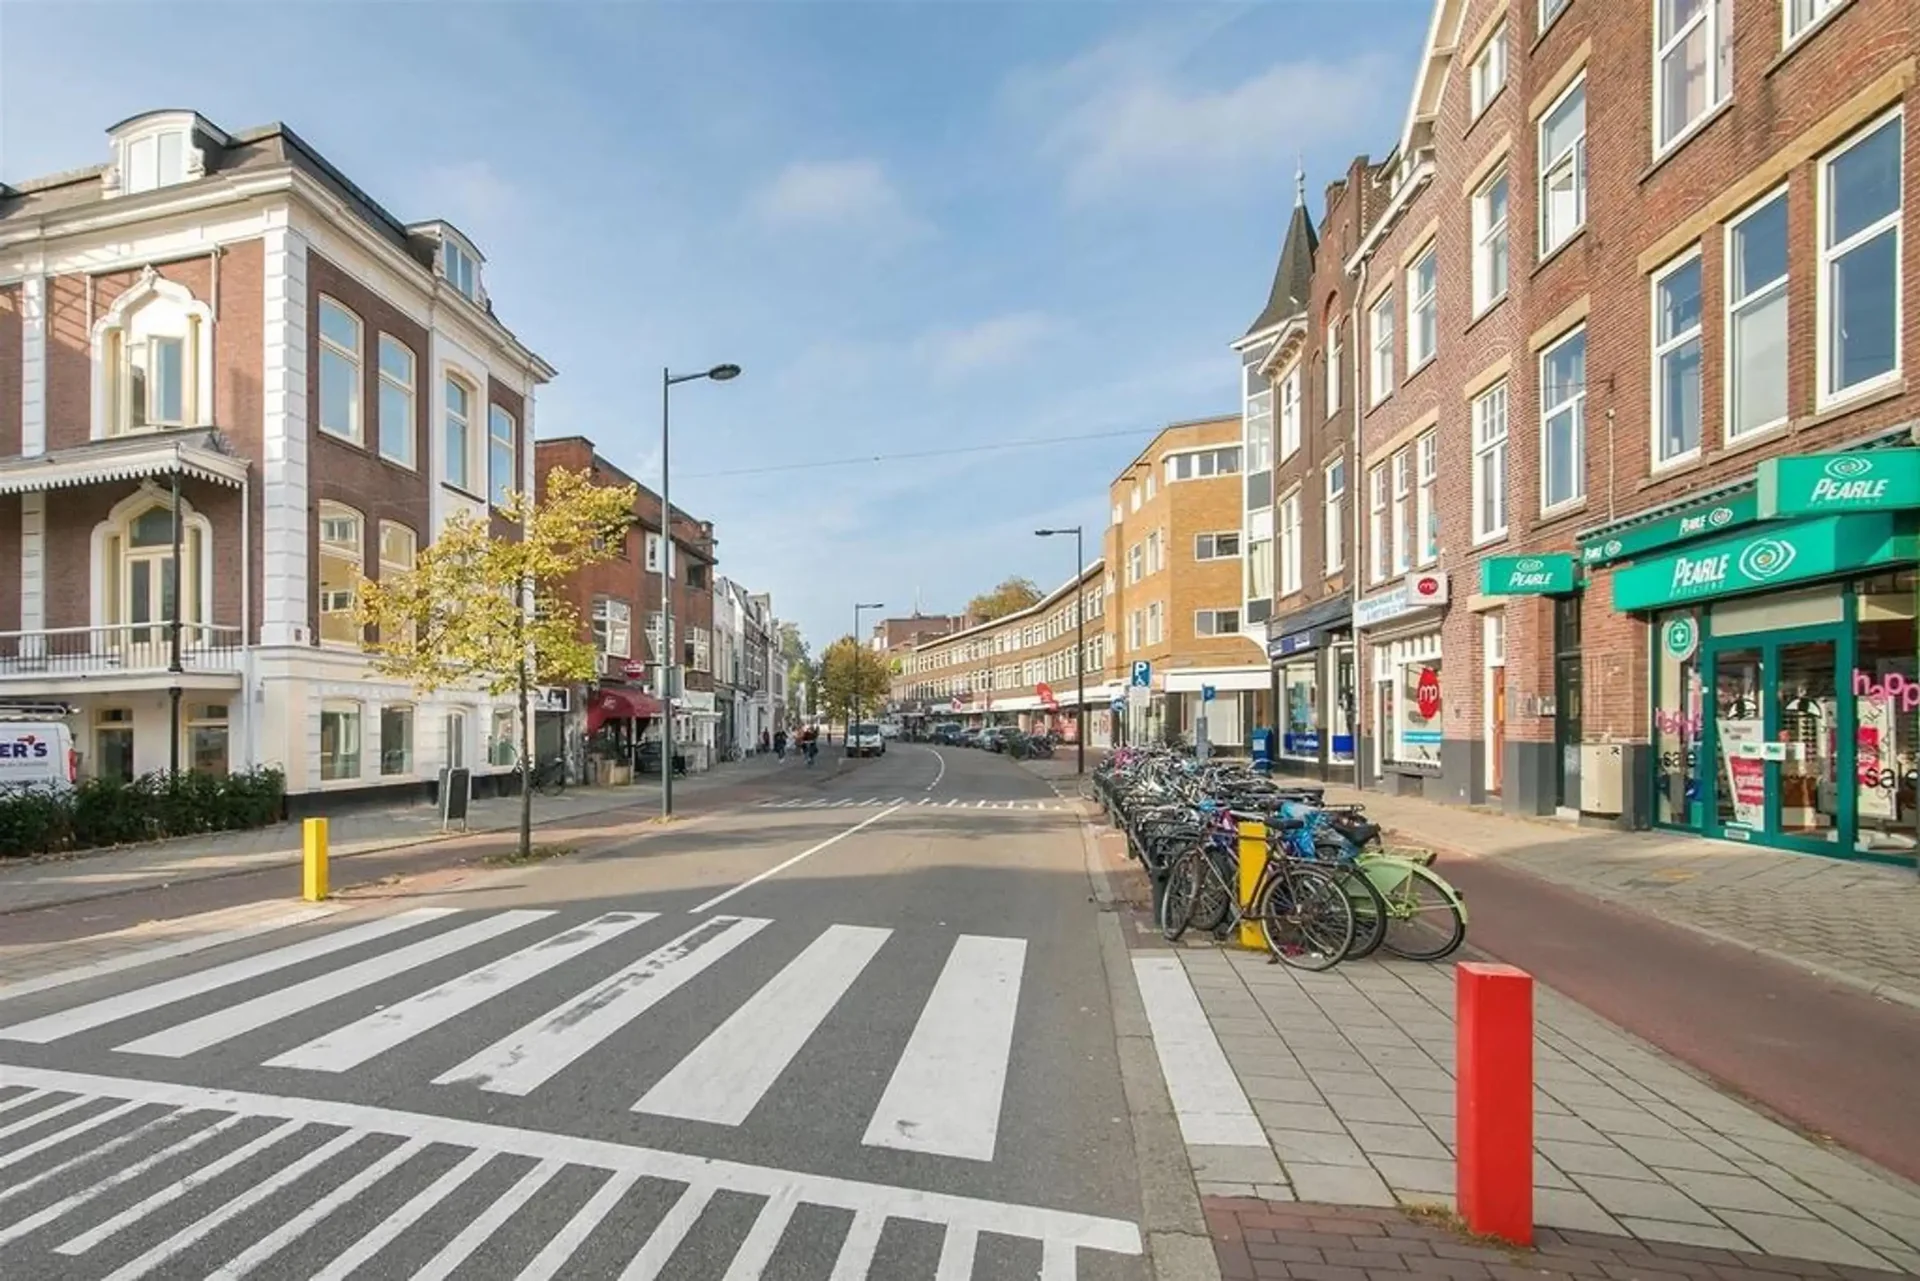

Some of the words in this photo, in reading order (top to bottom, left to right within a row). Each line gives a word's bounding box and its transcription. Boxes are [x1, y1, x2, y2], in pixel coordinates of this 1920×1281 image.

[1810, 477, 1890, 502] PEARLE
[1509, 571, 1554, 587] PEARLE
[1672, 554, 1730, 587] PEARLE
